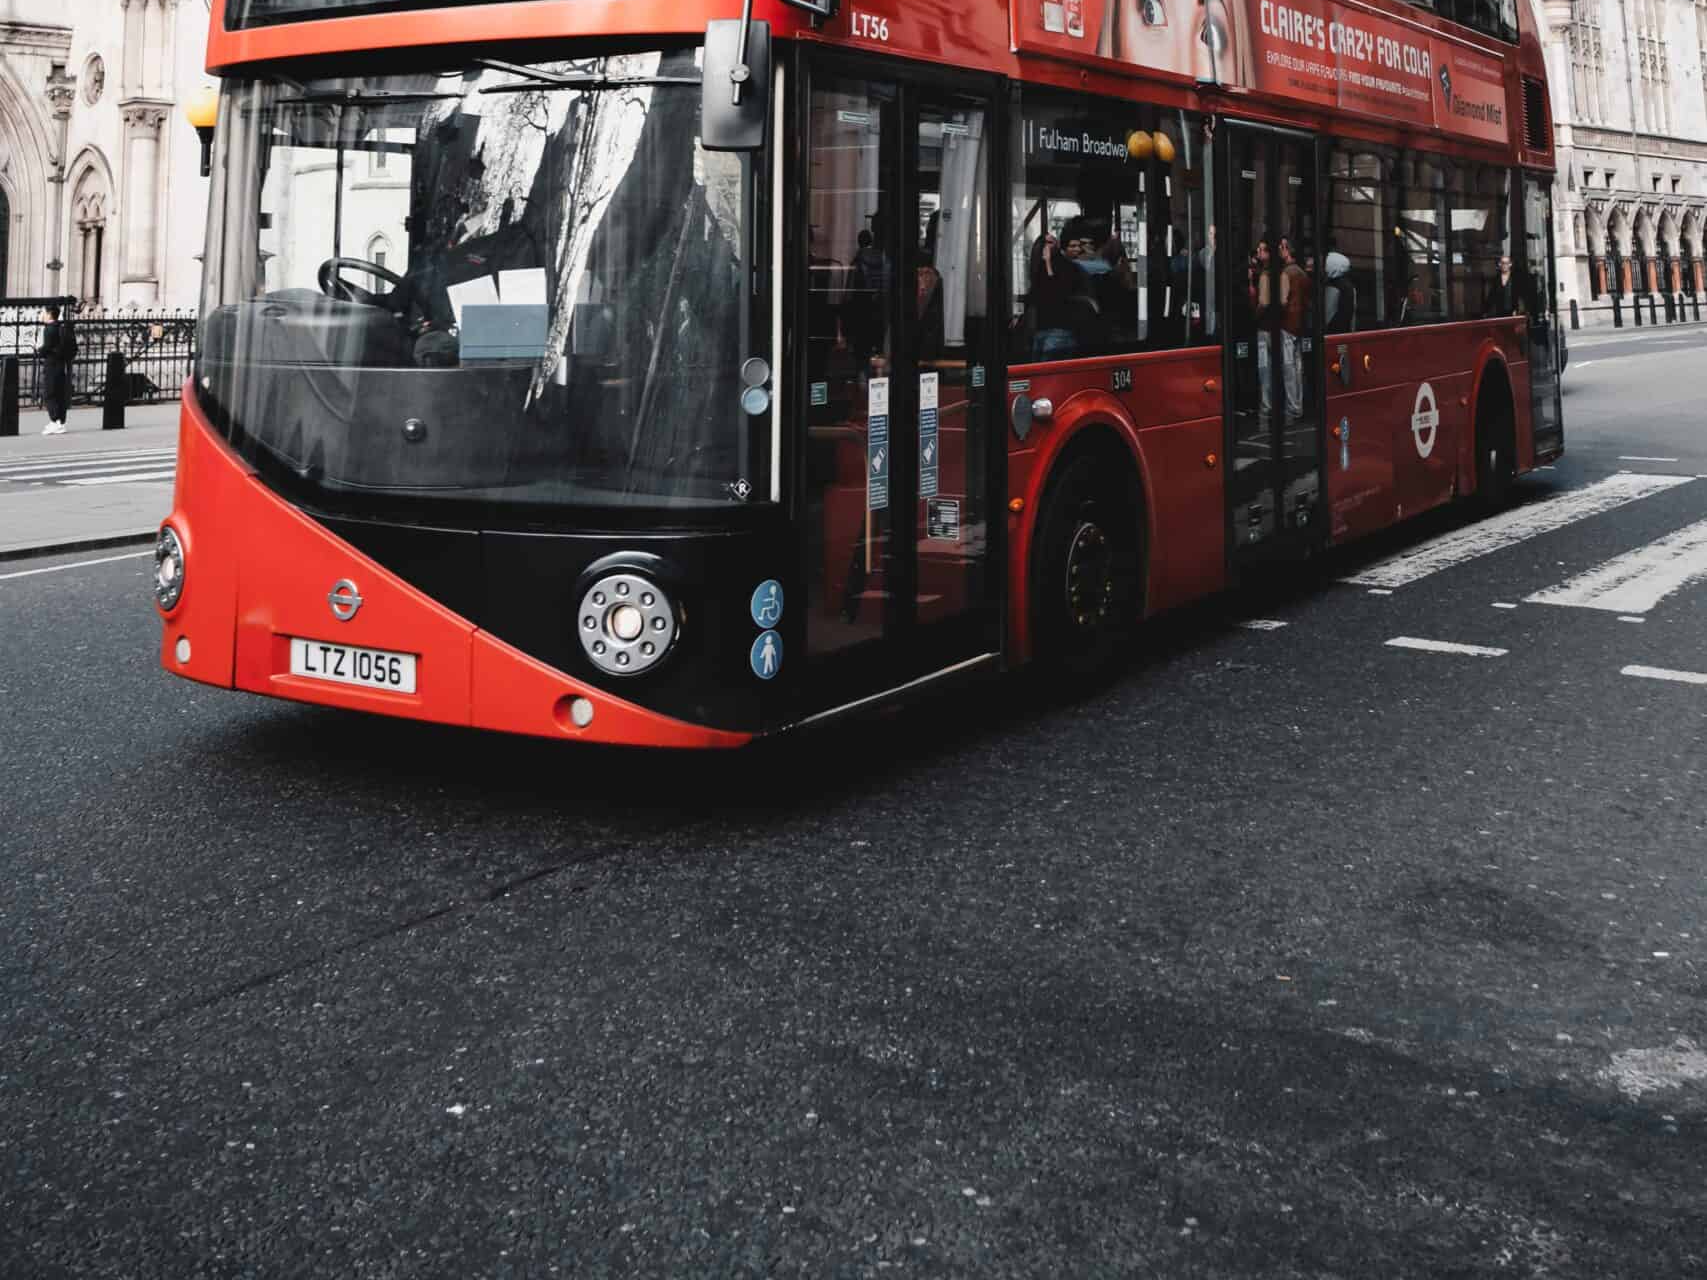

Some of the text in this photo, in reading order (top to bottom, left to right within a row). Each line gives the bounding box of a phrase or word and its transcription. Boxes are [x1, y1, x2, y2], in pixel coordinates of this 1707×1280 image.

[851, 11, 889, 41] LT56
[1260, 0, 1326, 51] CLAIRE'S
[1329, 22, 1374, 62] CRAZY
[1376, 35, 1401, 70] FOR
[1403, 43, 1432, 79] COLA
[1039, 127, 1080, 153] Fulham
[1082, 132, 1130, 163] Broadway
[1113, 370, 1131, 390] 304
[305, 643, 401, 685] LTZ 1056
